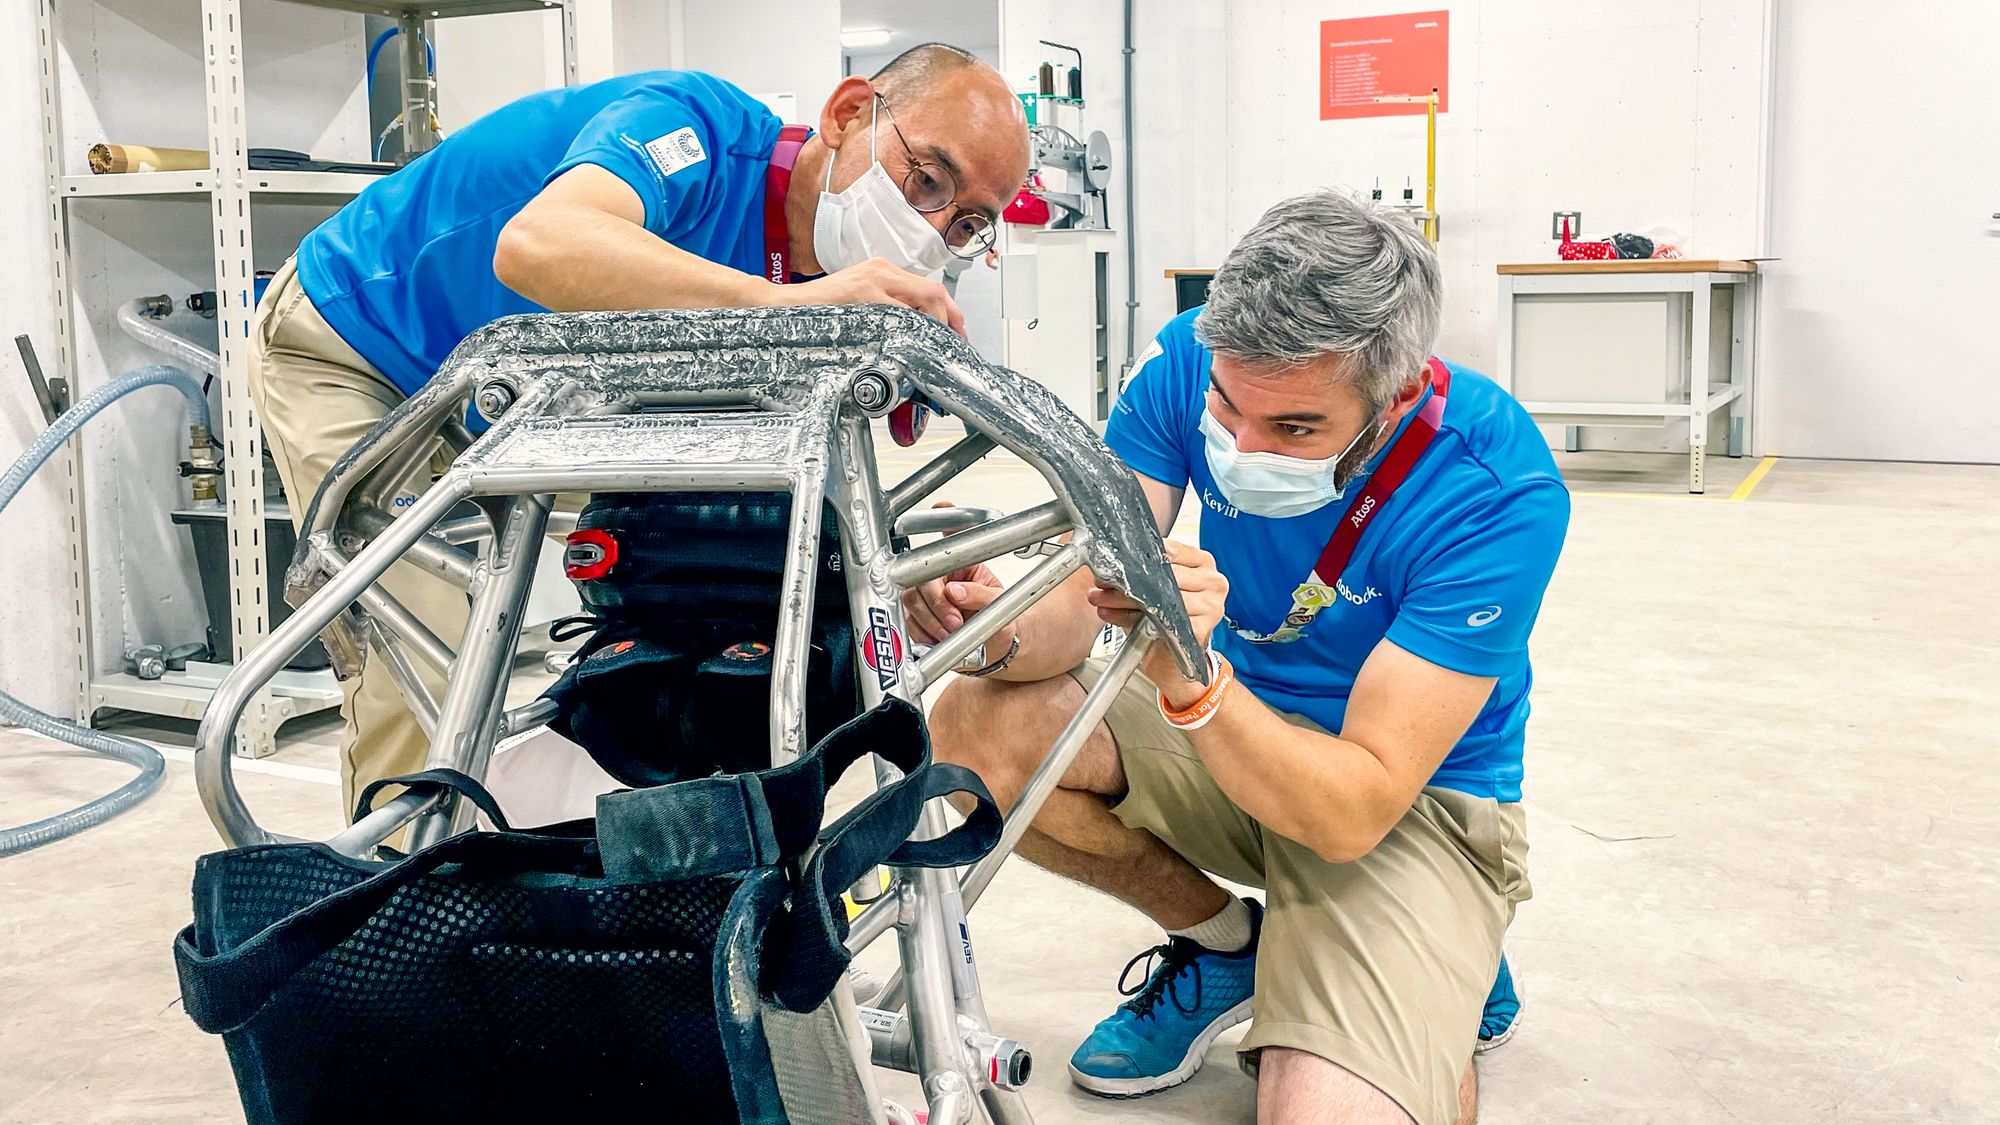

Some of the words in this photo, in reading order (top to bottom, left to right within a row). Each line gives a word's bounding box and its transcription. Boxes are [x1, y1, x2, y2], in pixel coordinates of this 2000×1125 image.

[1202, 487, 1239, 519] Kevin
[870, 608, 898, 689] VESCO
[1208, 673, 1231, 704] Passion
[1198, 702, 1212, 714] for
